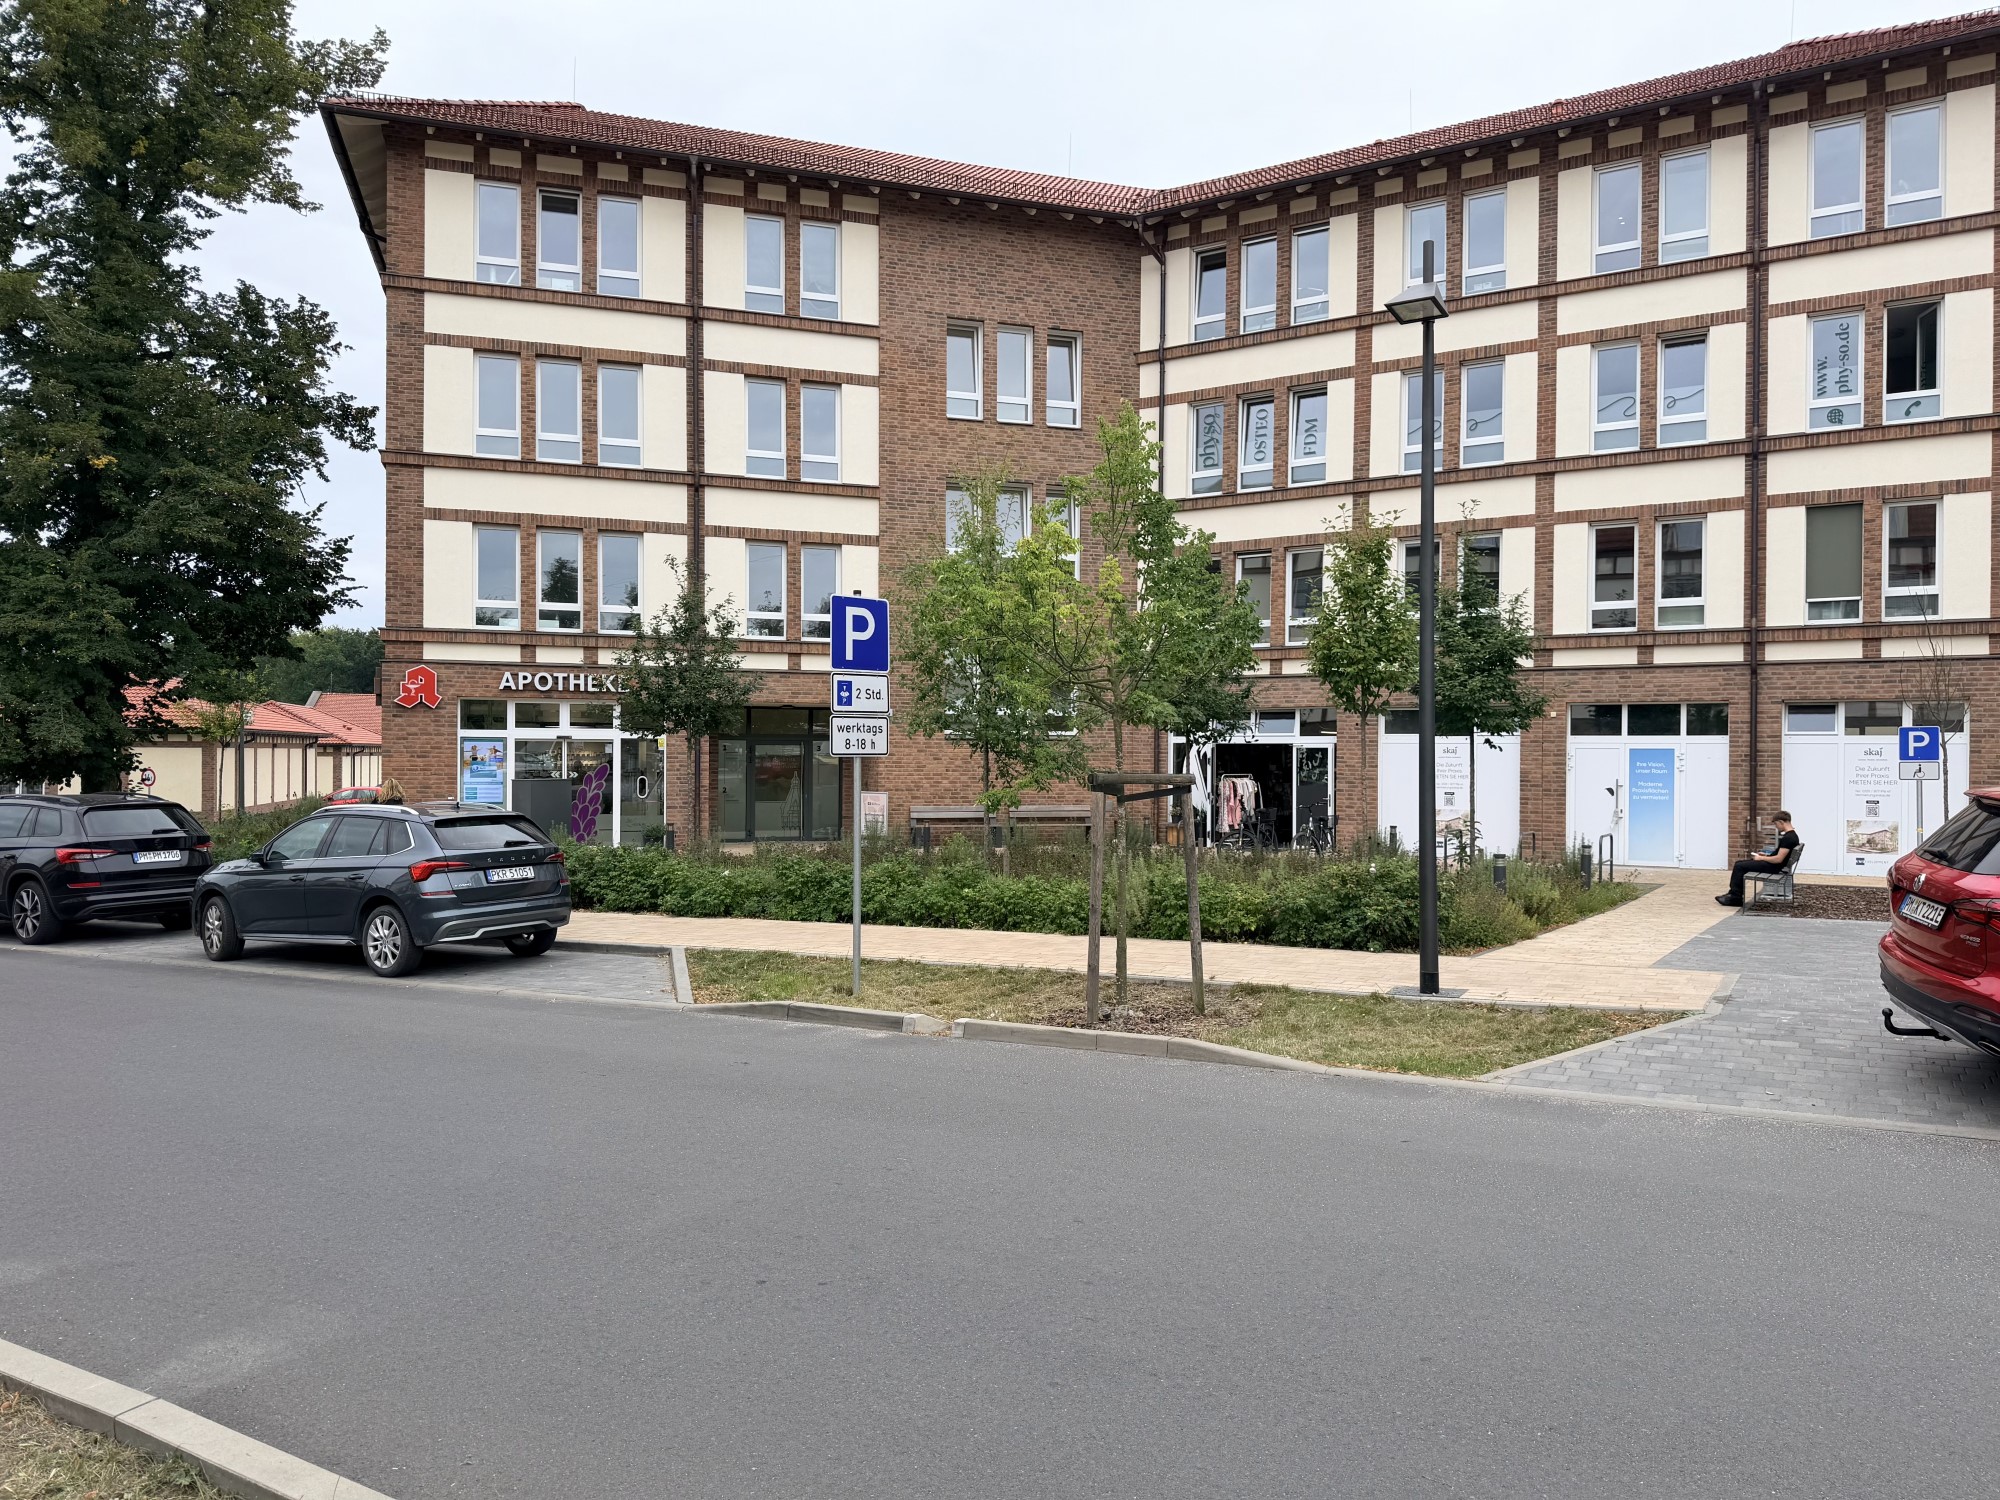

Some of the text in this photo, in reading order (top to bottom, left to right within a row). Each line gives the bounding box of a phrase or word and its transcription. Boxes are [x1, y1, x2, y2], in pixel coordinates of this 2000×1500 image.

[1834, 322, 1852, 394] phy-so.de
[1817, 356, 1828, 397] www.
[1254, 408, 1268, 462] OSTEO
[1303, 418, 1318, 456] FDM
[845, 605, 876, 661] P
[855, 687, 884, 700] 2 Std.
[837, 722, 883, 736] werktags
[845, 738, 876, 750] 8-18 h
[1908, 730, 1930, 757] P
[1442, 746, 1458, 756] skaj
[1863, 747, 1883, 758] skaj
[139, 852, 149, 861] PM
[491, 867, 534, 880] PKR 51051
